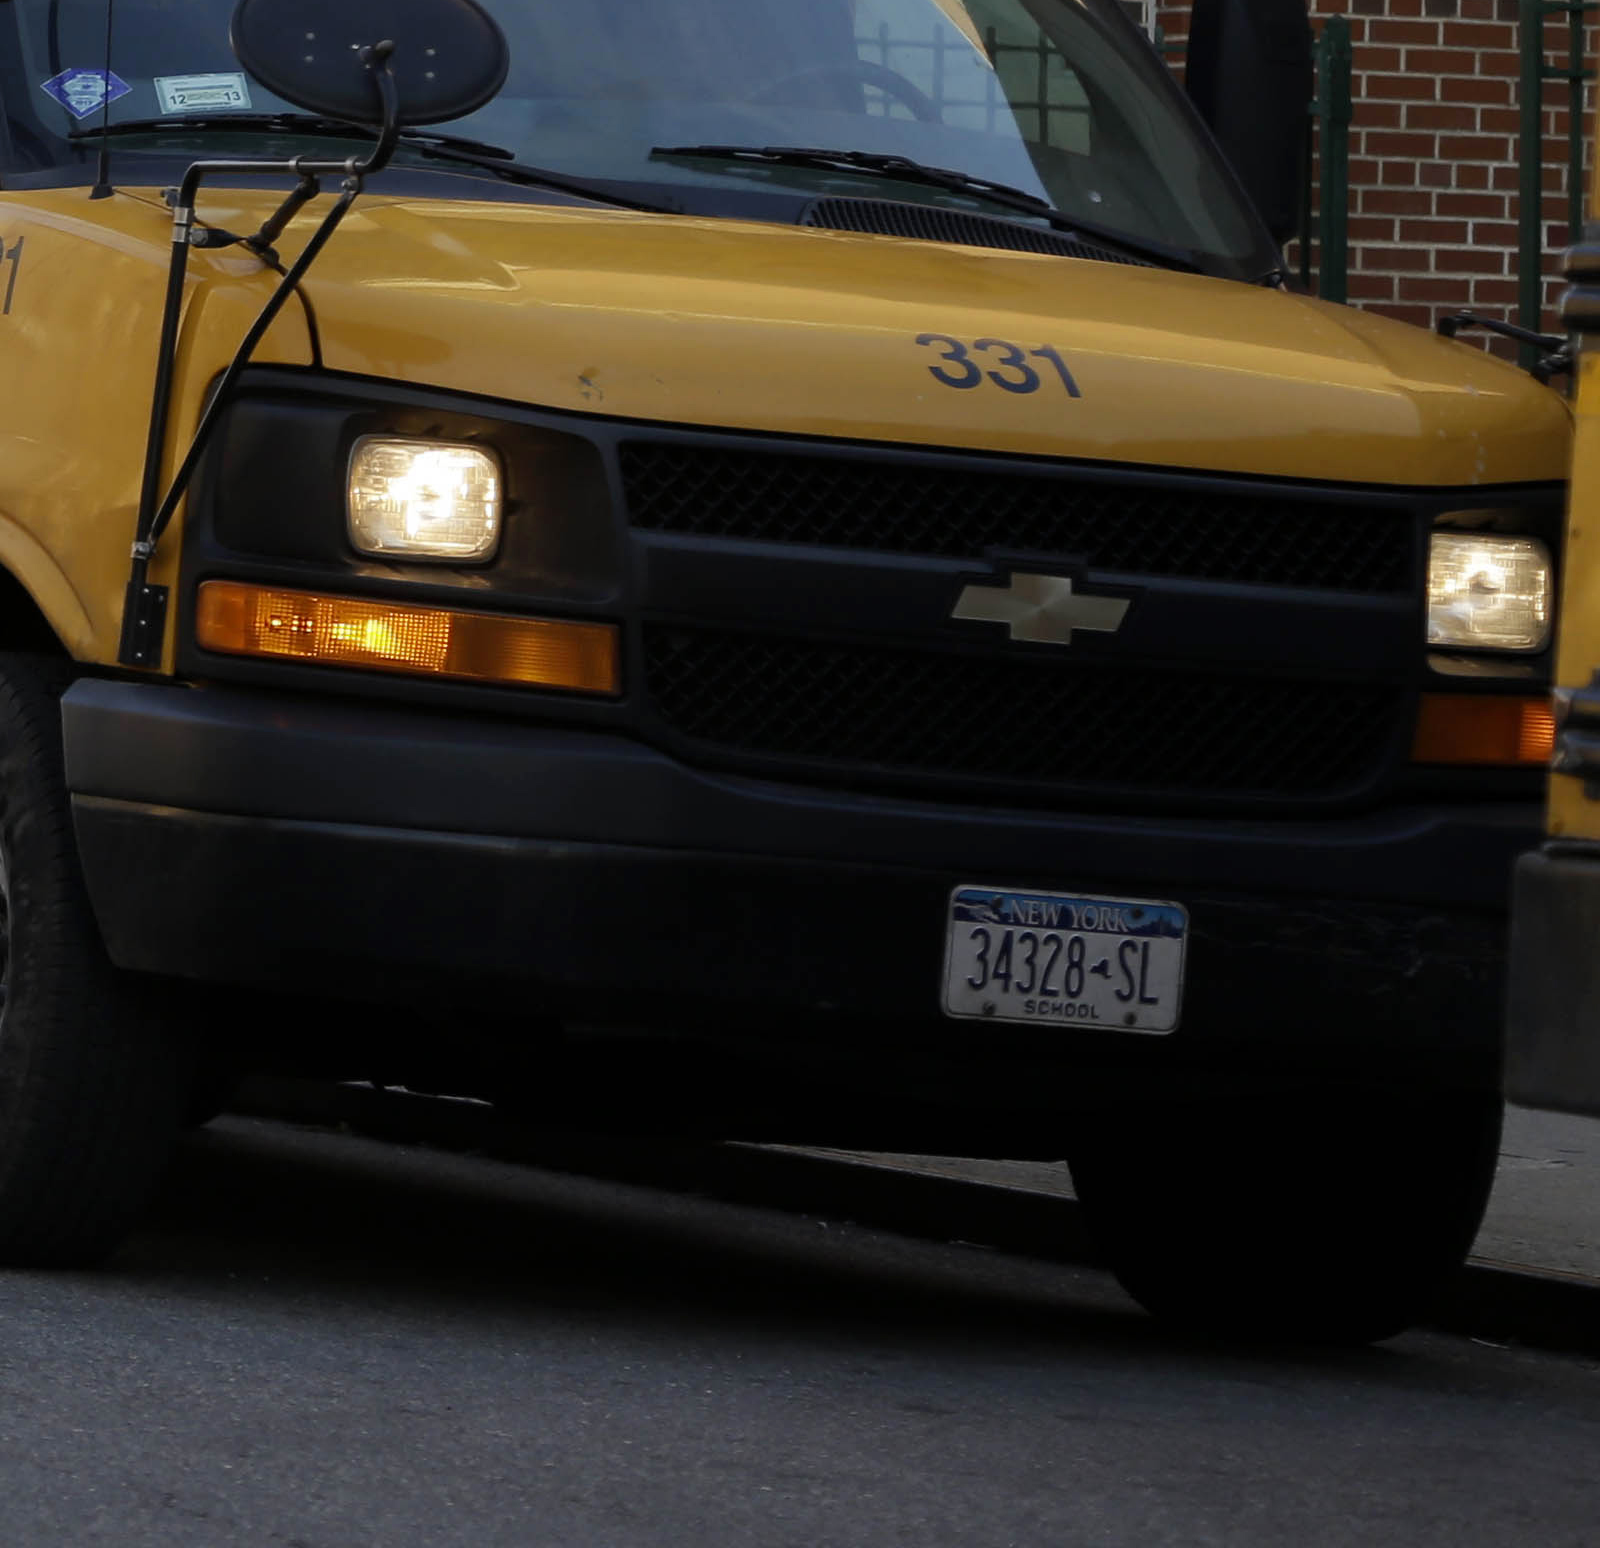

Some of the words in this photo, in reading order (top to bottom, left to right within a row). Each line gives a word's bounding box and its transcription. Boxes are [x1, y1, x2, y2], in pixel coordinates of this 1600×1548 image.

[169, 94, 187, 105] 12
[223, 91, 241, 101] 13
[915, 332, 1082, 398] 331
[1008, 899, 1064, 927] NEW
[1070, 904, 1130, 933] YORK
[967, 925, 1087, 999] 34328
[1114, 939, 1159, 1006] SL
[1023, 999, 1100, 1020] SCHOOL
